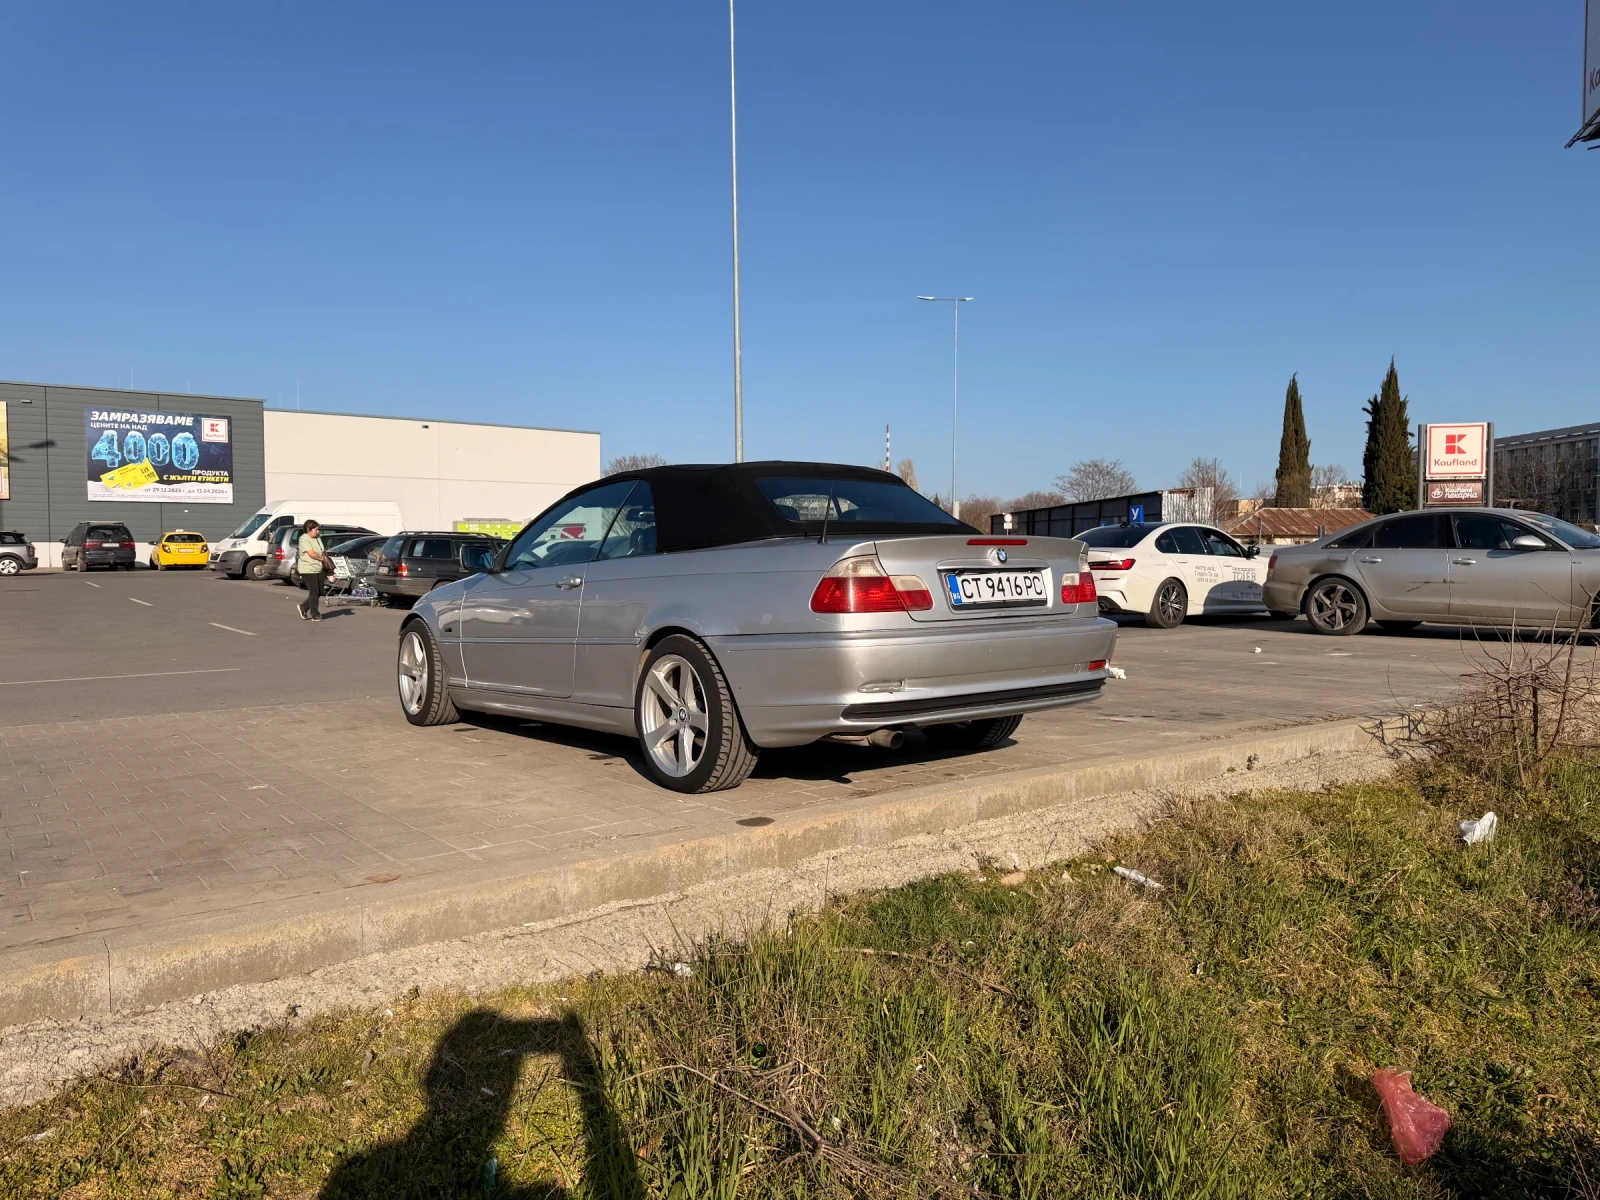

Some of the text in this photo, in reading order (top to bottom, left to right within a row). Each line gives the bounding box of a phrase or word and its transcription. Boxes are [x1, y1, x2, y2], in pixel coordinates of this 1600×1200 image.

[90, 411, 194, 427] ЗАМРАЗЯВАМЕ
[91, 429, 200, 471] 4000
[1434, 458, 1478, 467] Kaufland
[191, 469, 229, 477] ПРОДУКТА
[197, 475, 229, 483] ЕТИКЕТИ
[952, 592, 961, 600] BG
